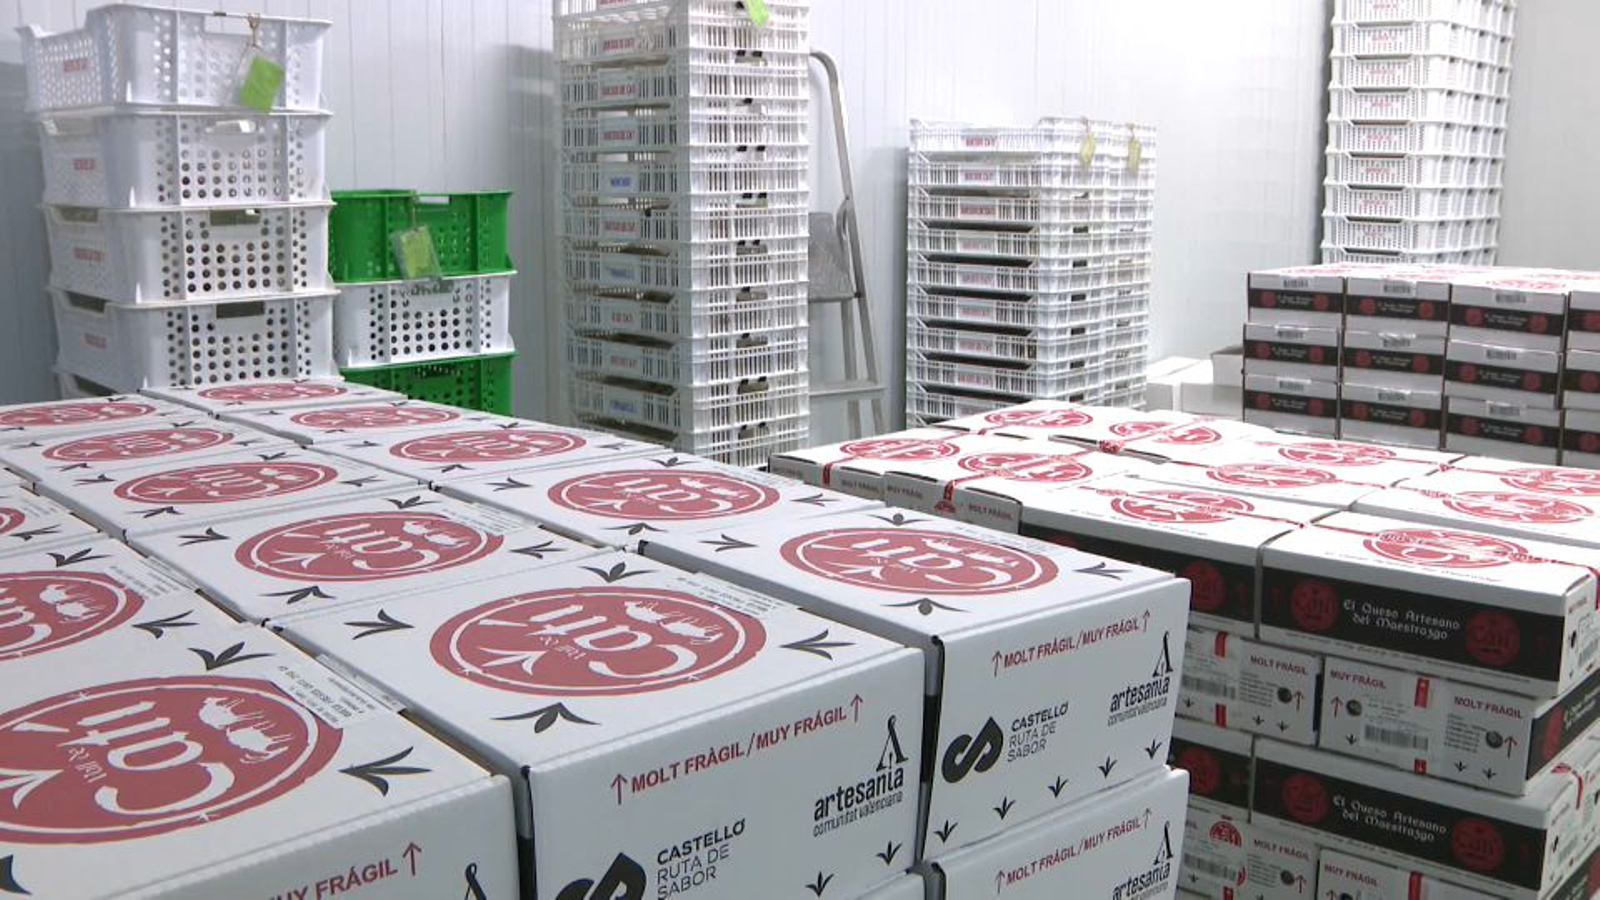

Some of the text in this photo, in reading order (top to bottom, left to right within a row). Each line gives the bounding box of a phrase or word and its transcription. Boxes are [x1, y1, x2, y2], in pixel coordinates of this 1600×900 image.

[1405, 610, 1460, 630] Artesano
[1004, 647, 1035, 668] MOLT
[1250, 655, 1274, 667] MOLT
[1454, 696, 1483, 709] MOLT
[1009, 721, 1057, 748] RUTA DE
[631, 762, 680, 793] MOLT
[793, 706, 847, 738] FRÁGIL
[1007, 739, 1046, 763] SABOR
[1393, 811, 1447, 834] Artesano
[657, 843, 730, 885] RUTA DE
[1006, 861, 1037, 886] MOLT
[315, 859, 398, 900] FRÁGIL
[657, 865, 717, 900] SABOR
